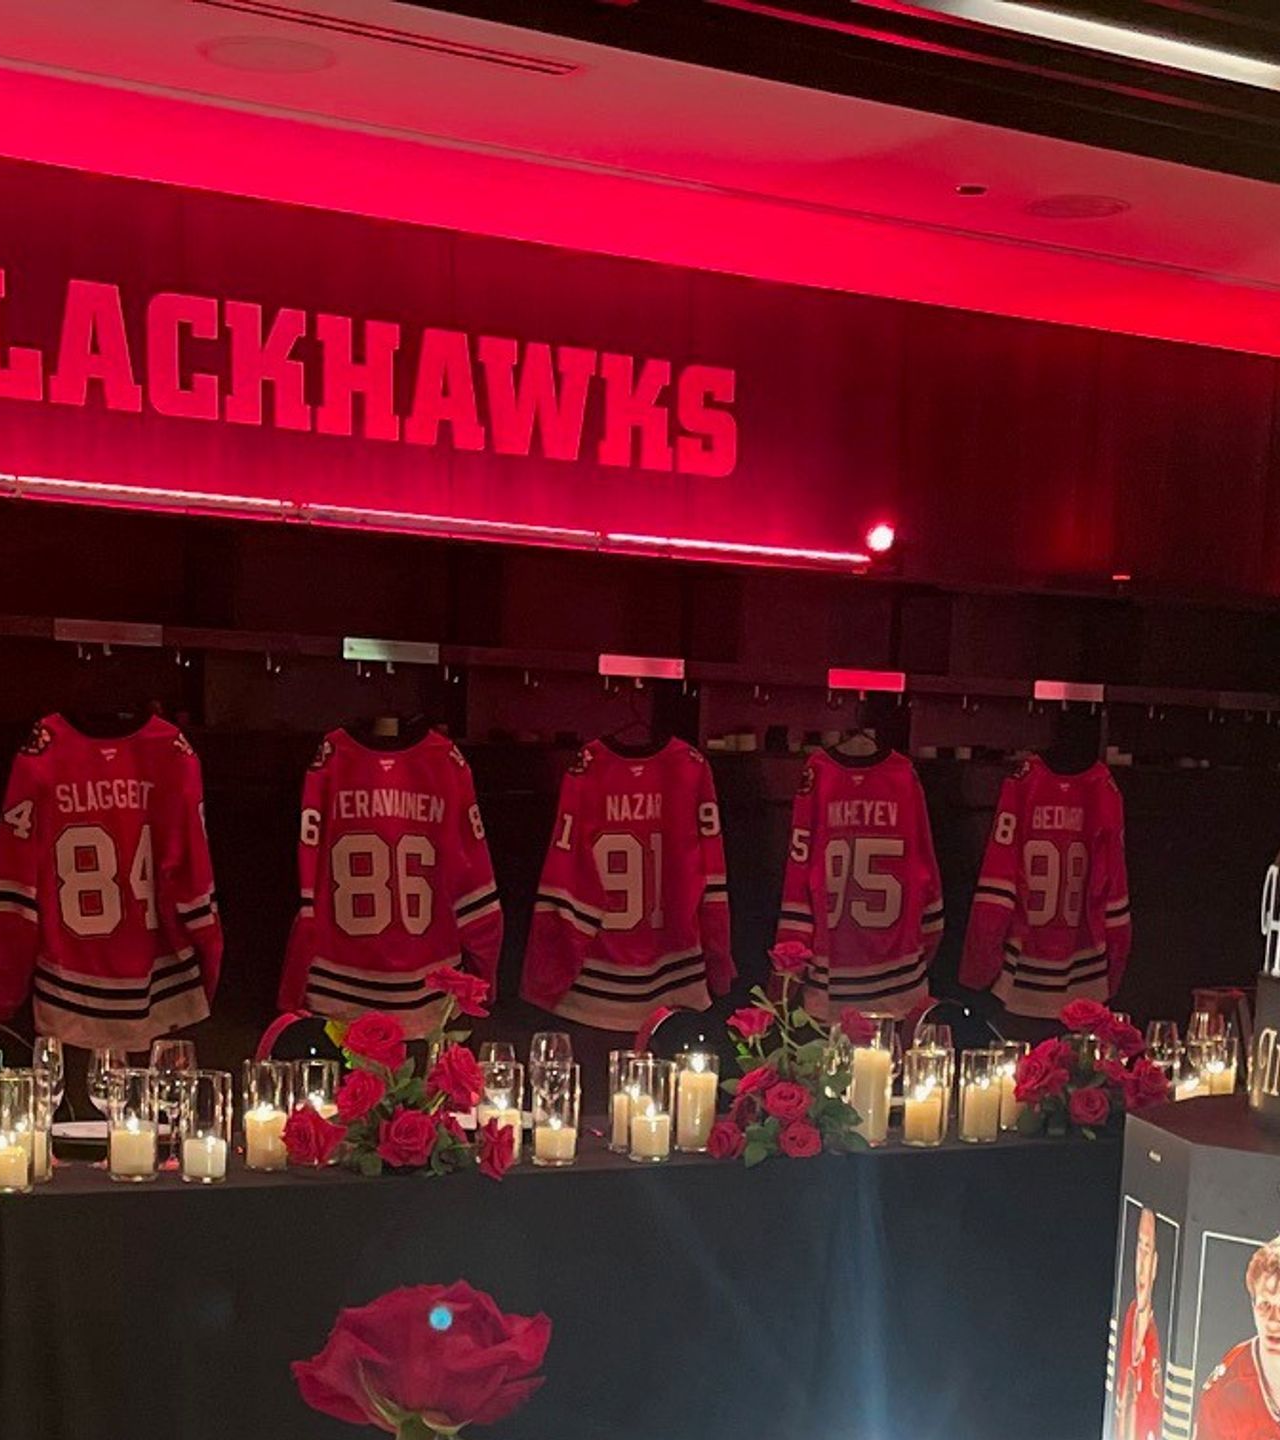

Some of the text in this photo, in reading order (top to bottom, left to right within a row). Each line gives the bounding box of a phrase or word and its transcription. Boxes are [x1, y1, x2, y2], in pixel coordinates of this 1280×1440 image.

[606, 793, 663, 822] NAZAR
[55, 825, 159, 936] 84
[331, 834, 436, 936] 86
[592, 833, 665, 931] 91
[825, 837, 905, 929] 95
[1023, 839, 1089, 928] 98
